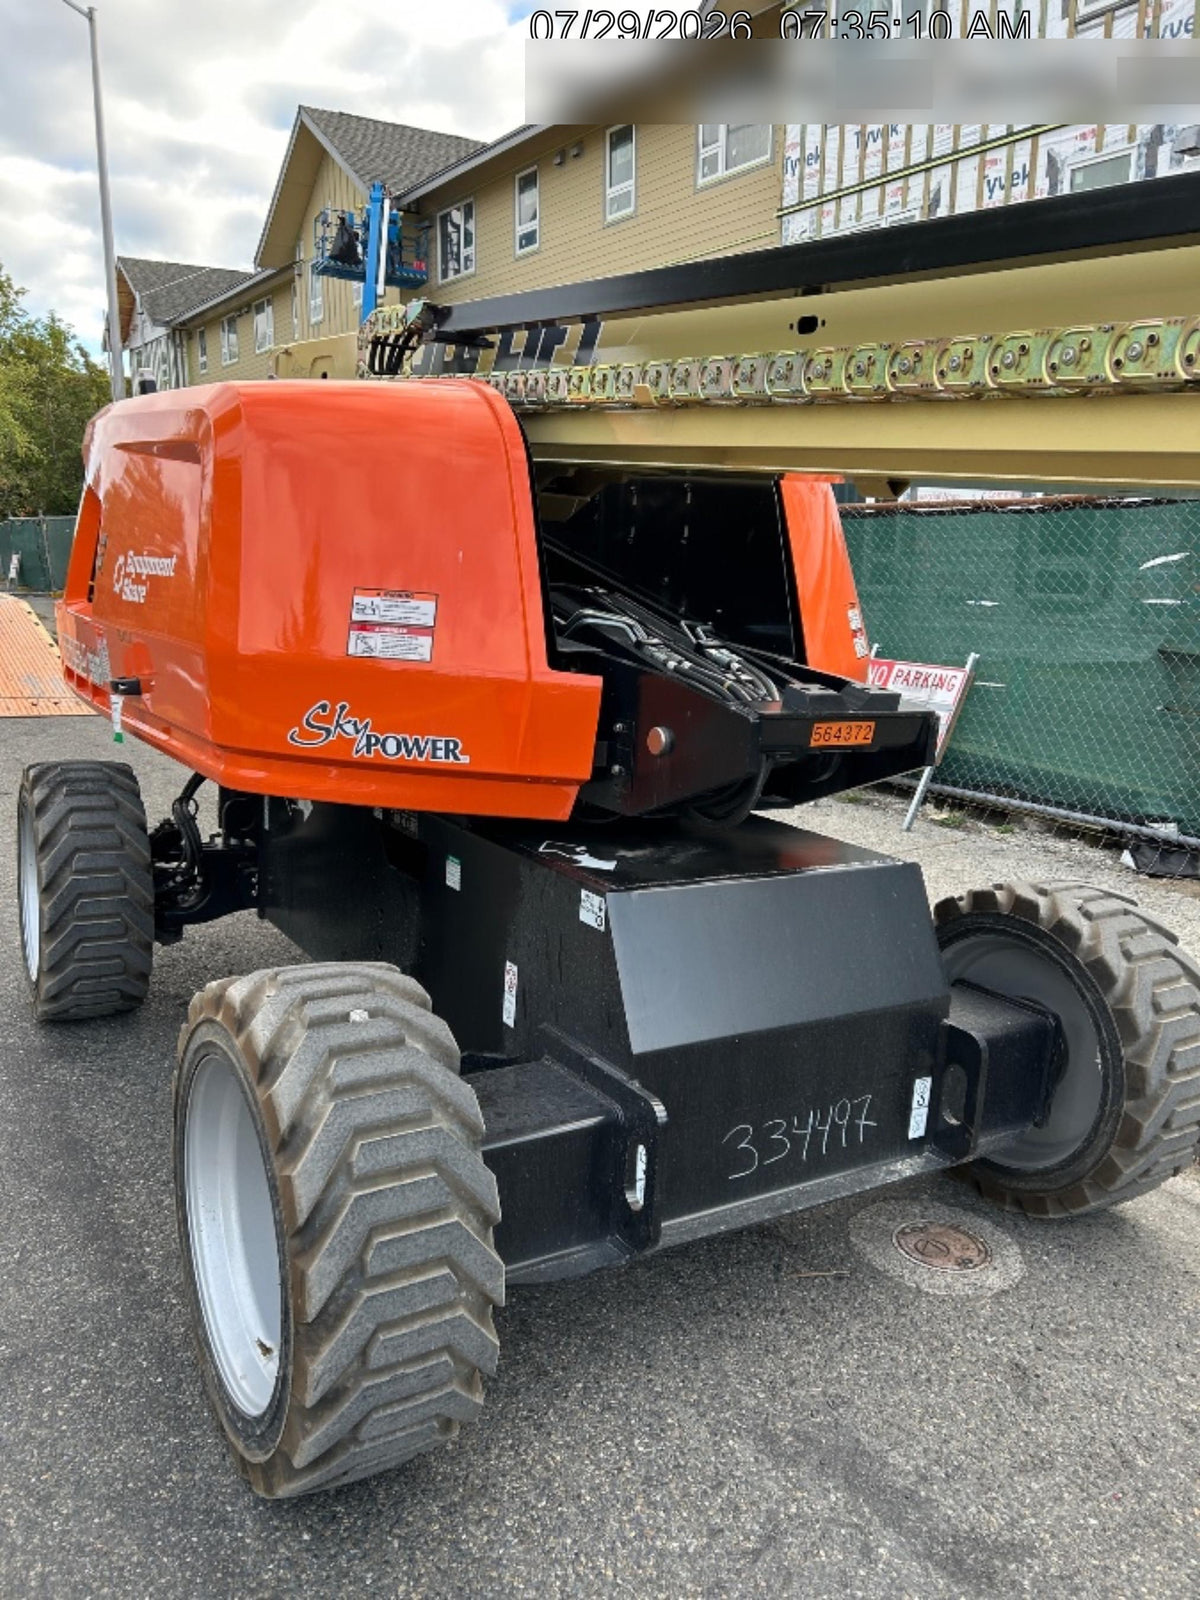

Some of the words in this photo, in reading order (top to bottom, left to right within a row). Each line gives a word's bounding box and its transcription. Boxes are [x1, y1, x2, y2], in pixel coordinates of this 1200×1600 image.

[892, 668, 958, 692] PARKING
[813, 725, 873, 744] 564372
[721, 1094, 878, 1180] 334497
